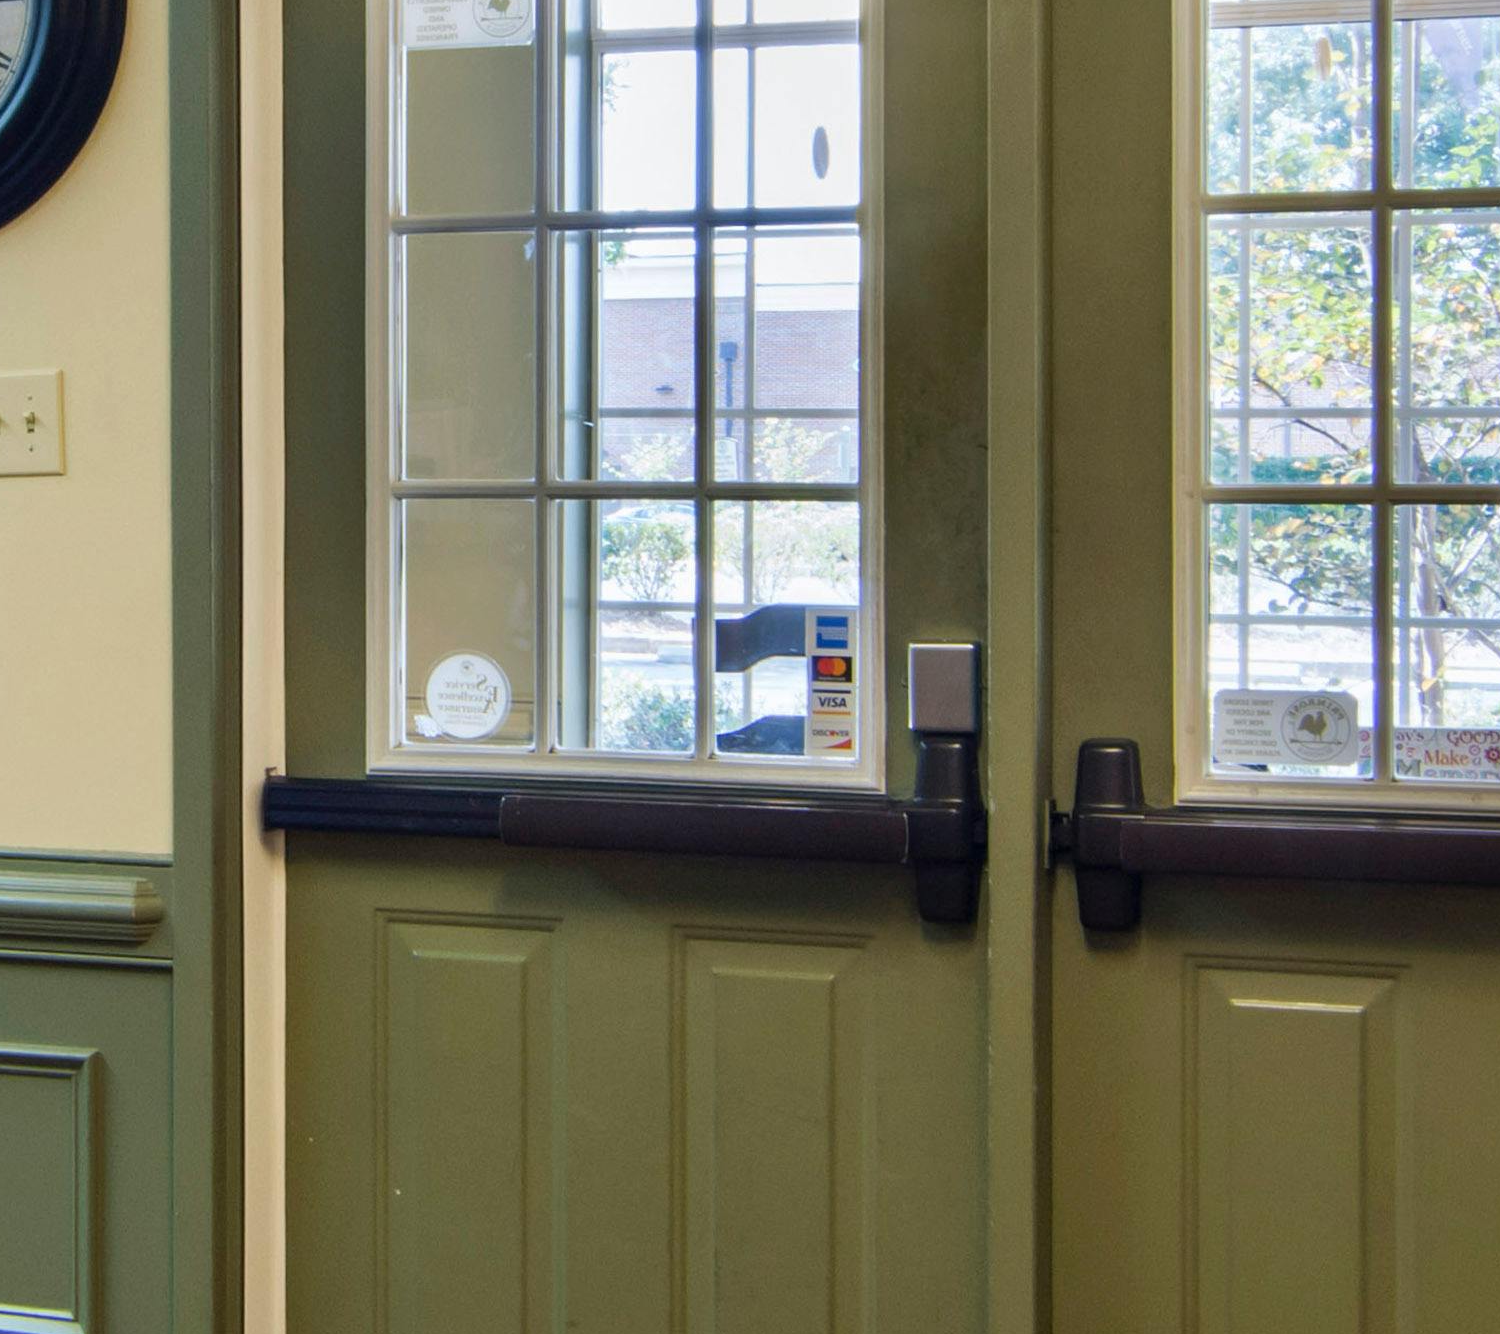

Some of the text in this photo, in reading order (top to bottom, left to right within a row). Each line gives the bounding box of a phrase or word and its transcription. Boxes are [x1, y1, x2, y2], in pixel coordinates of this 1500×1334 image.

[818, 696, 848, 708] VISA
[812, 729, 849, 737] DISCOVER
[1446, 729, 1500, 747] GOOD
[1423, 749, 1470, 766] Make
[1471, 756, 1483, 767] a
